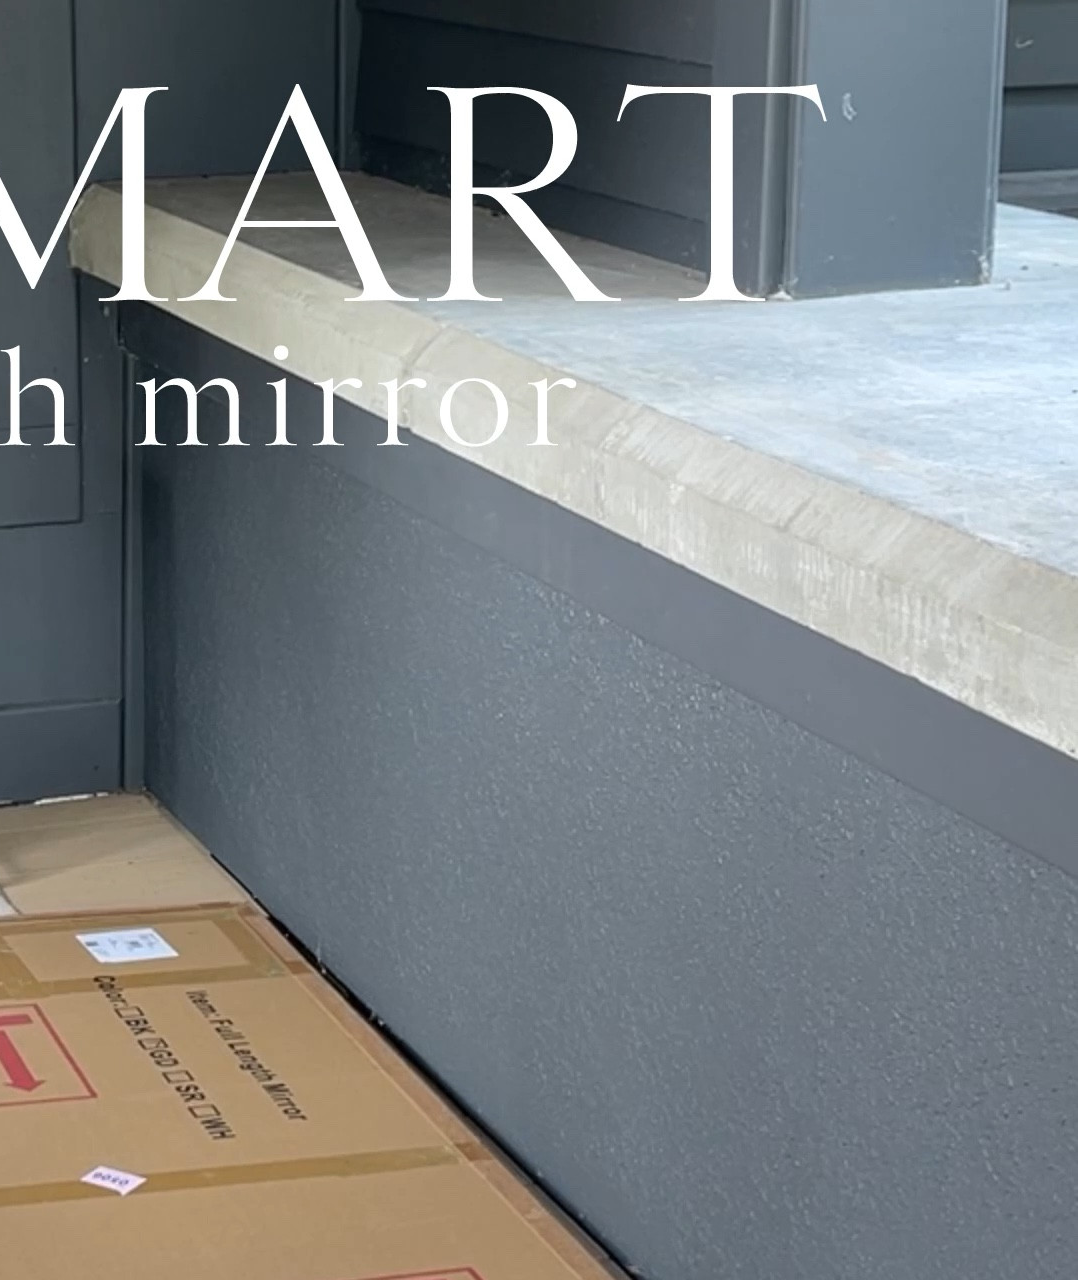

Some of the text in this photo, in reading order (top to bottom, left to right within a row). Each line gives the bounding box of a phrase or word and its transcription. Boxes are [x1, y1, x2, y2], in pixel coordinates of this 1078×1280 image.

[209, 1017, 245, 1041] Full
[227, 1040, 276, 1083] Length
[261, 1082, 307, 1121] Mirror
